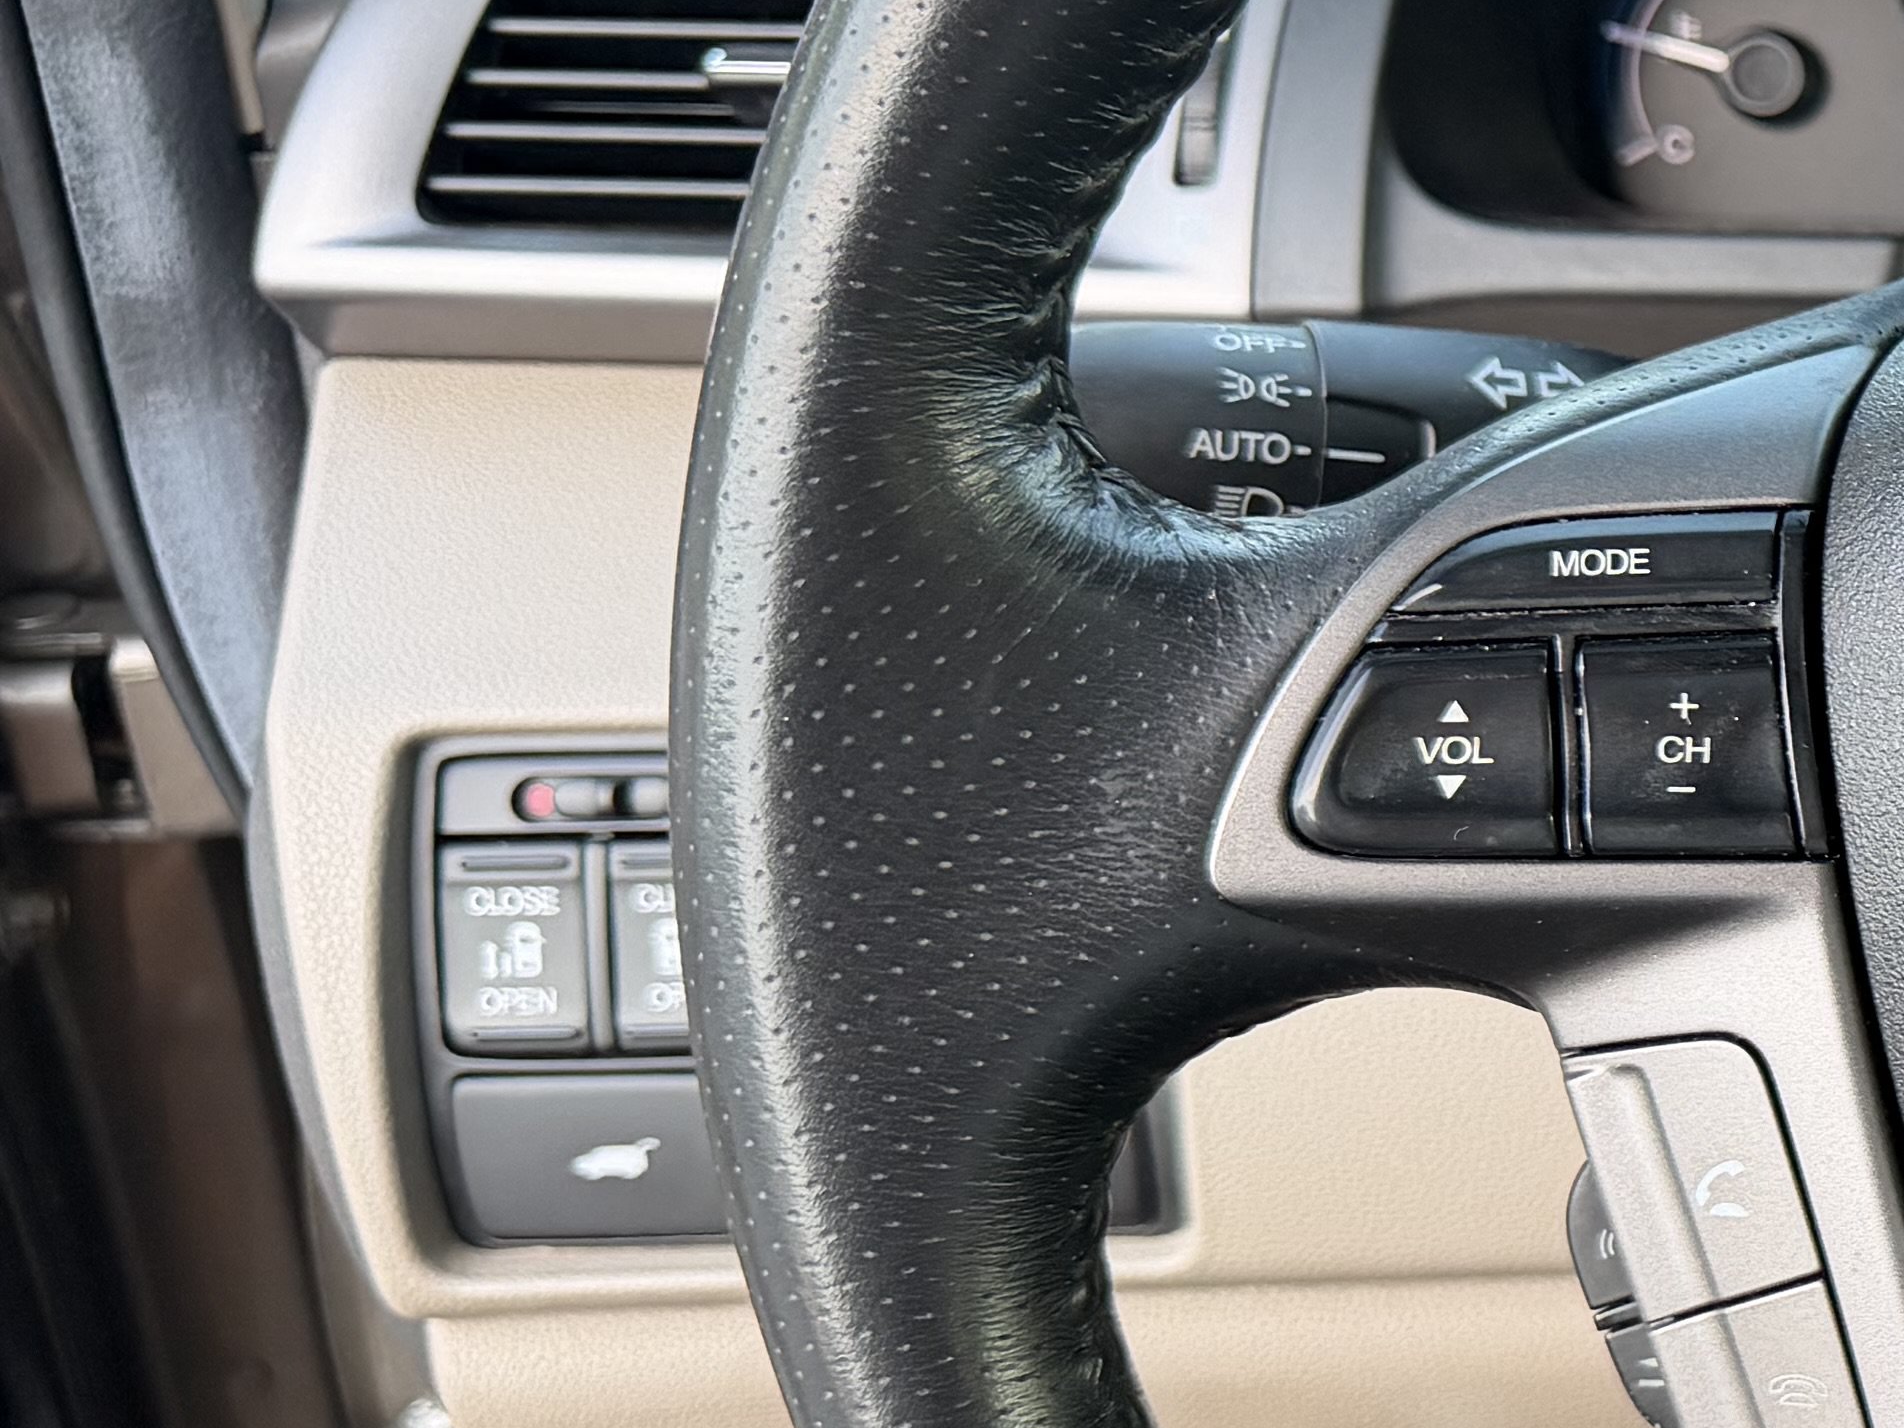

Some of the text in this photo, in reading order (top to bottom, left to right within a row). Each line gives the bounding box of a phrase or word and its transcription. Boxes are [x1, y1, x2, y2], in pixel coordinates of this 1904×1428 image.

[1187, 429, 1292, 465] AUTO
[1551, 546, 1651, 578] MODE
[1415, 735, 1495, 766] VOL
[1656, 735, 1712, 766] CH
[464, 885, 562, 918] CLOSE
[479, 985, 558, 1017] OPEN
